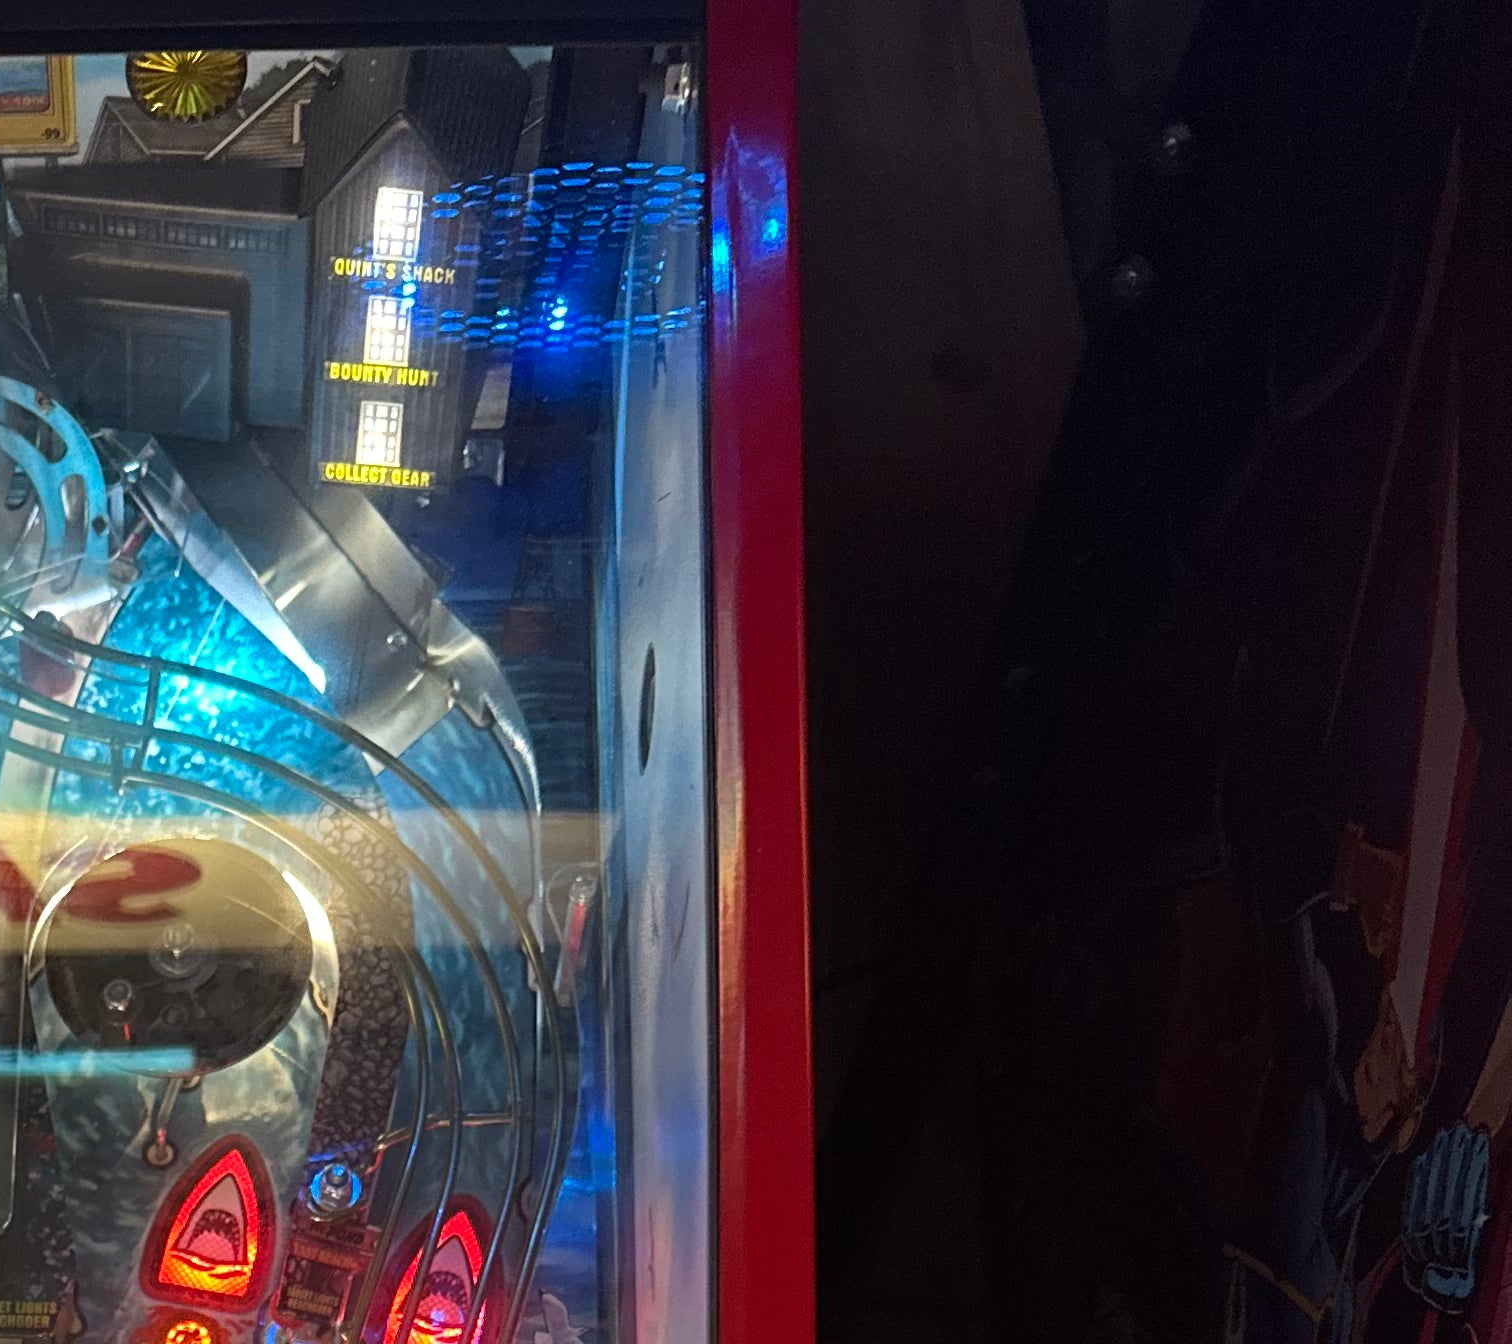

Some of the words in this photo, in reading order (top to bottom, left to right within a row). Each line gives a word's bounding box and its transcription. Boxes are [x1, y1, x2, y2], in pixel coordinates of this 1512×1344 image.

[334, 258, 397, 280] QUINT'S
[401, 262, 456, 284] SHACK
[329, 362, 393, 385] BOUNTY
[397, 368, 439, 387] HUNT
[325, 463, 388, 484] COLLECT
[391, 470, 431, 487] GEAR
